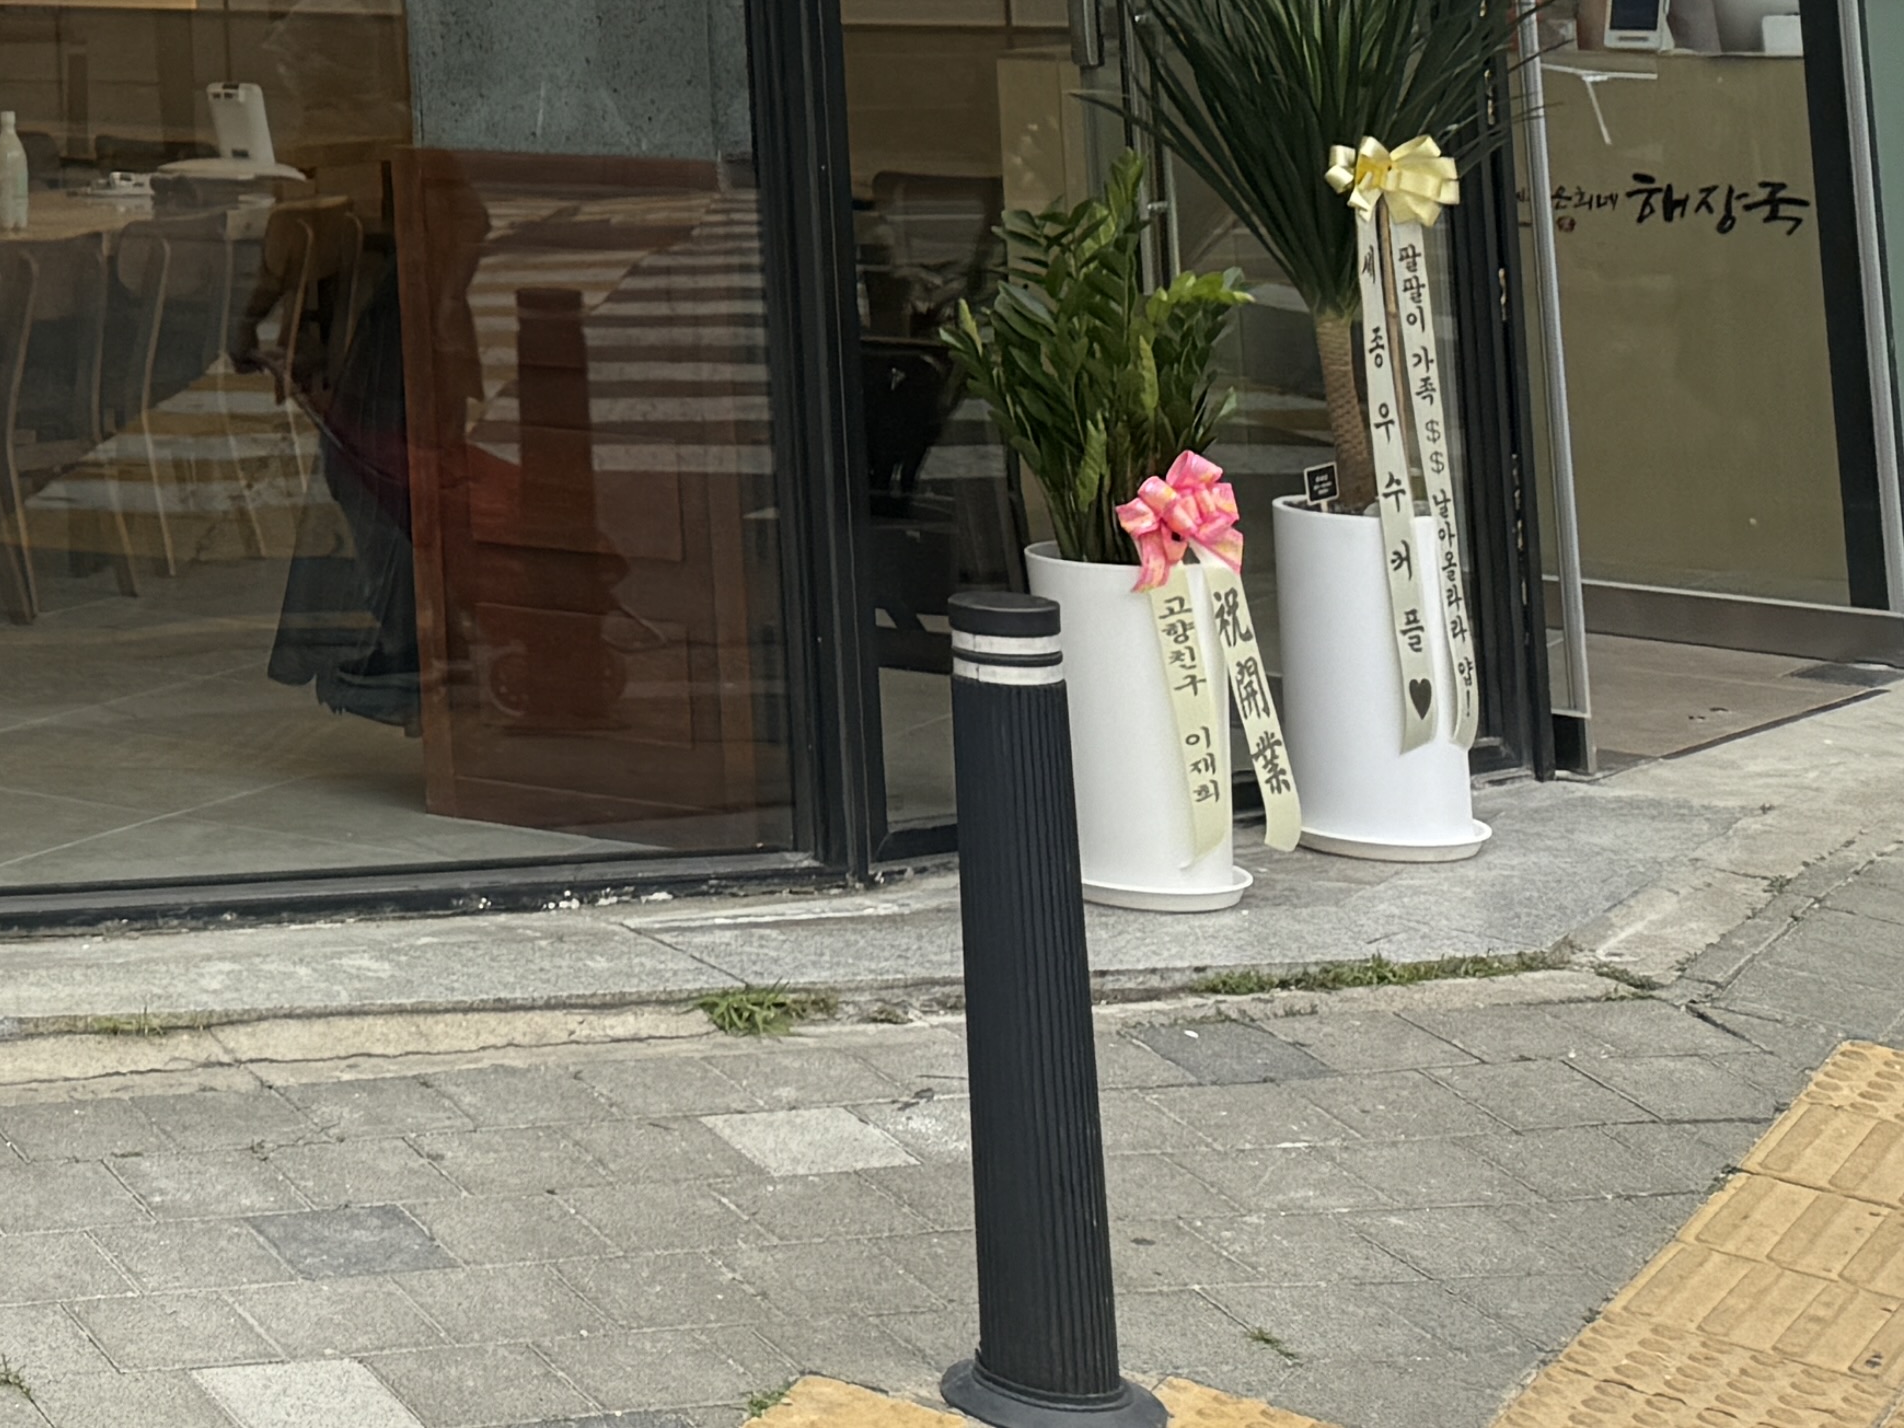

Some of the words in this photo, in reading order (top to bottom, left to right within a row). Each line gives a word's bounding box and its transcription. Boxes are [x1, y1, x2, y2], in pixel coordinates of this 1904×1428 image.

[1625, 172, 1811, 236] 해장국
[1411, 344, 1439, 406] 가족
[1157, 595, 1208, 697] 고향친구
[1184, 725, 1221, 804] 이재희
